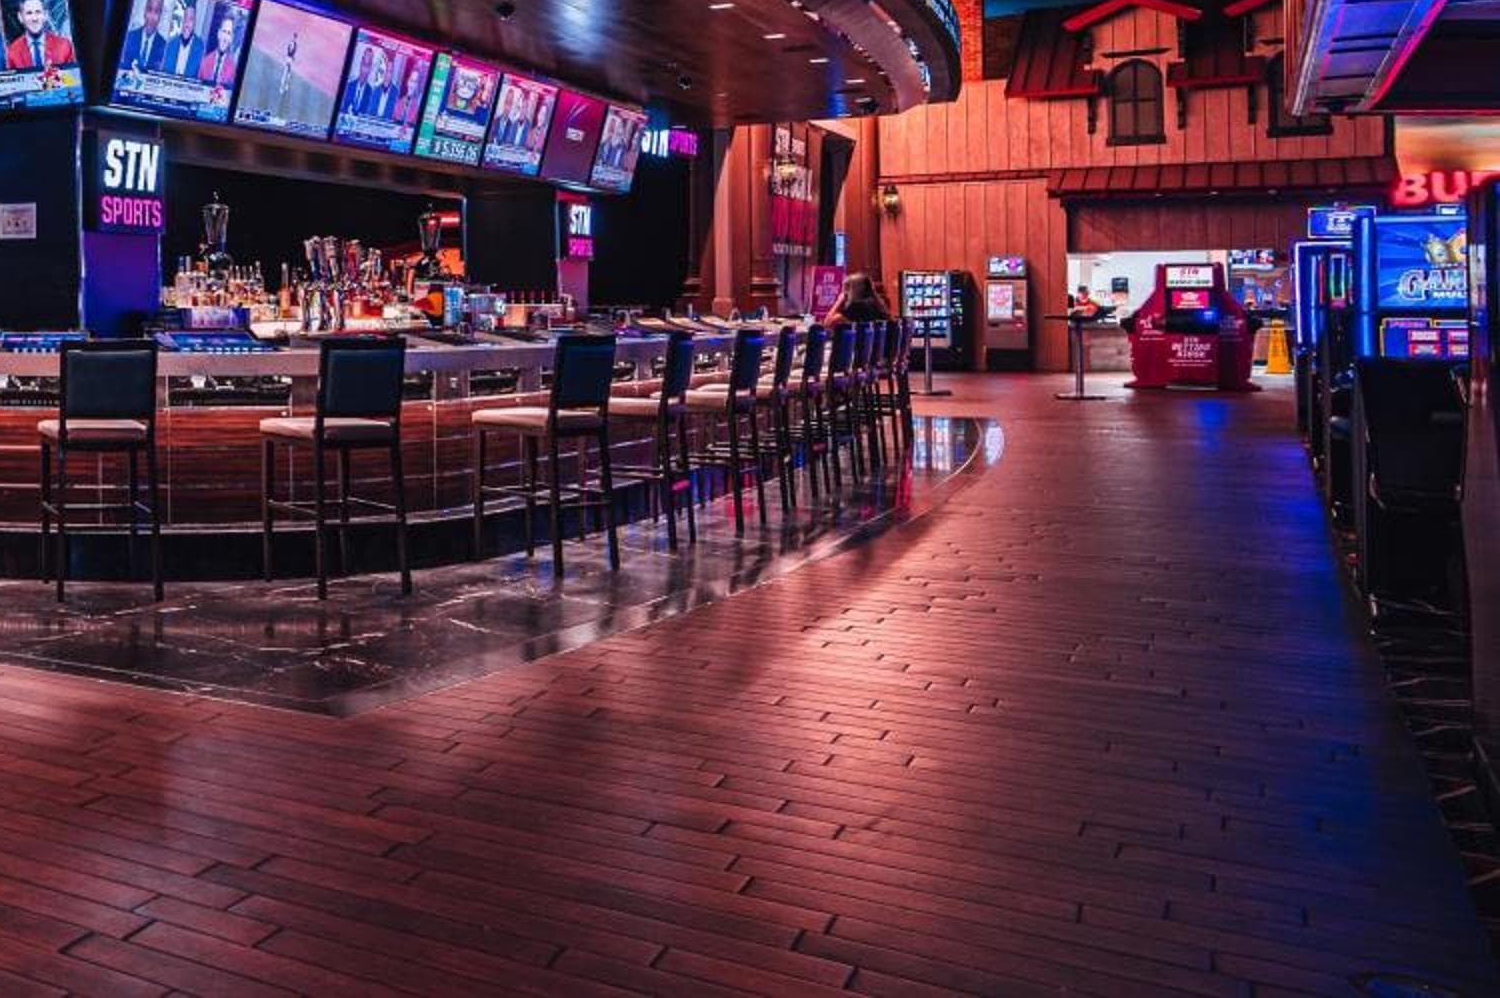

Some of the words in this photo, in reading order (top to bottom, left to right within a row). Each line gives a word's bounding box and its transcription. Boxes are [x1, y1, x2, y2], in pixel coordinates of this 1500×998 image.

[103, 138, 160, 192] STN
[100, 195, 162, 228] SPORTS
[570, 205, 591, 235] STN
